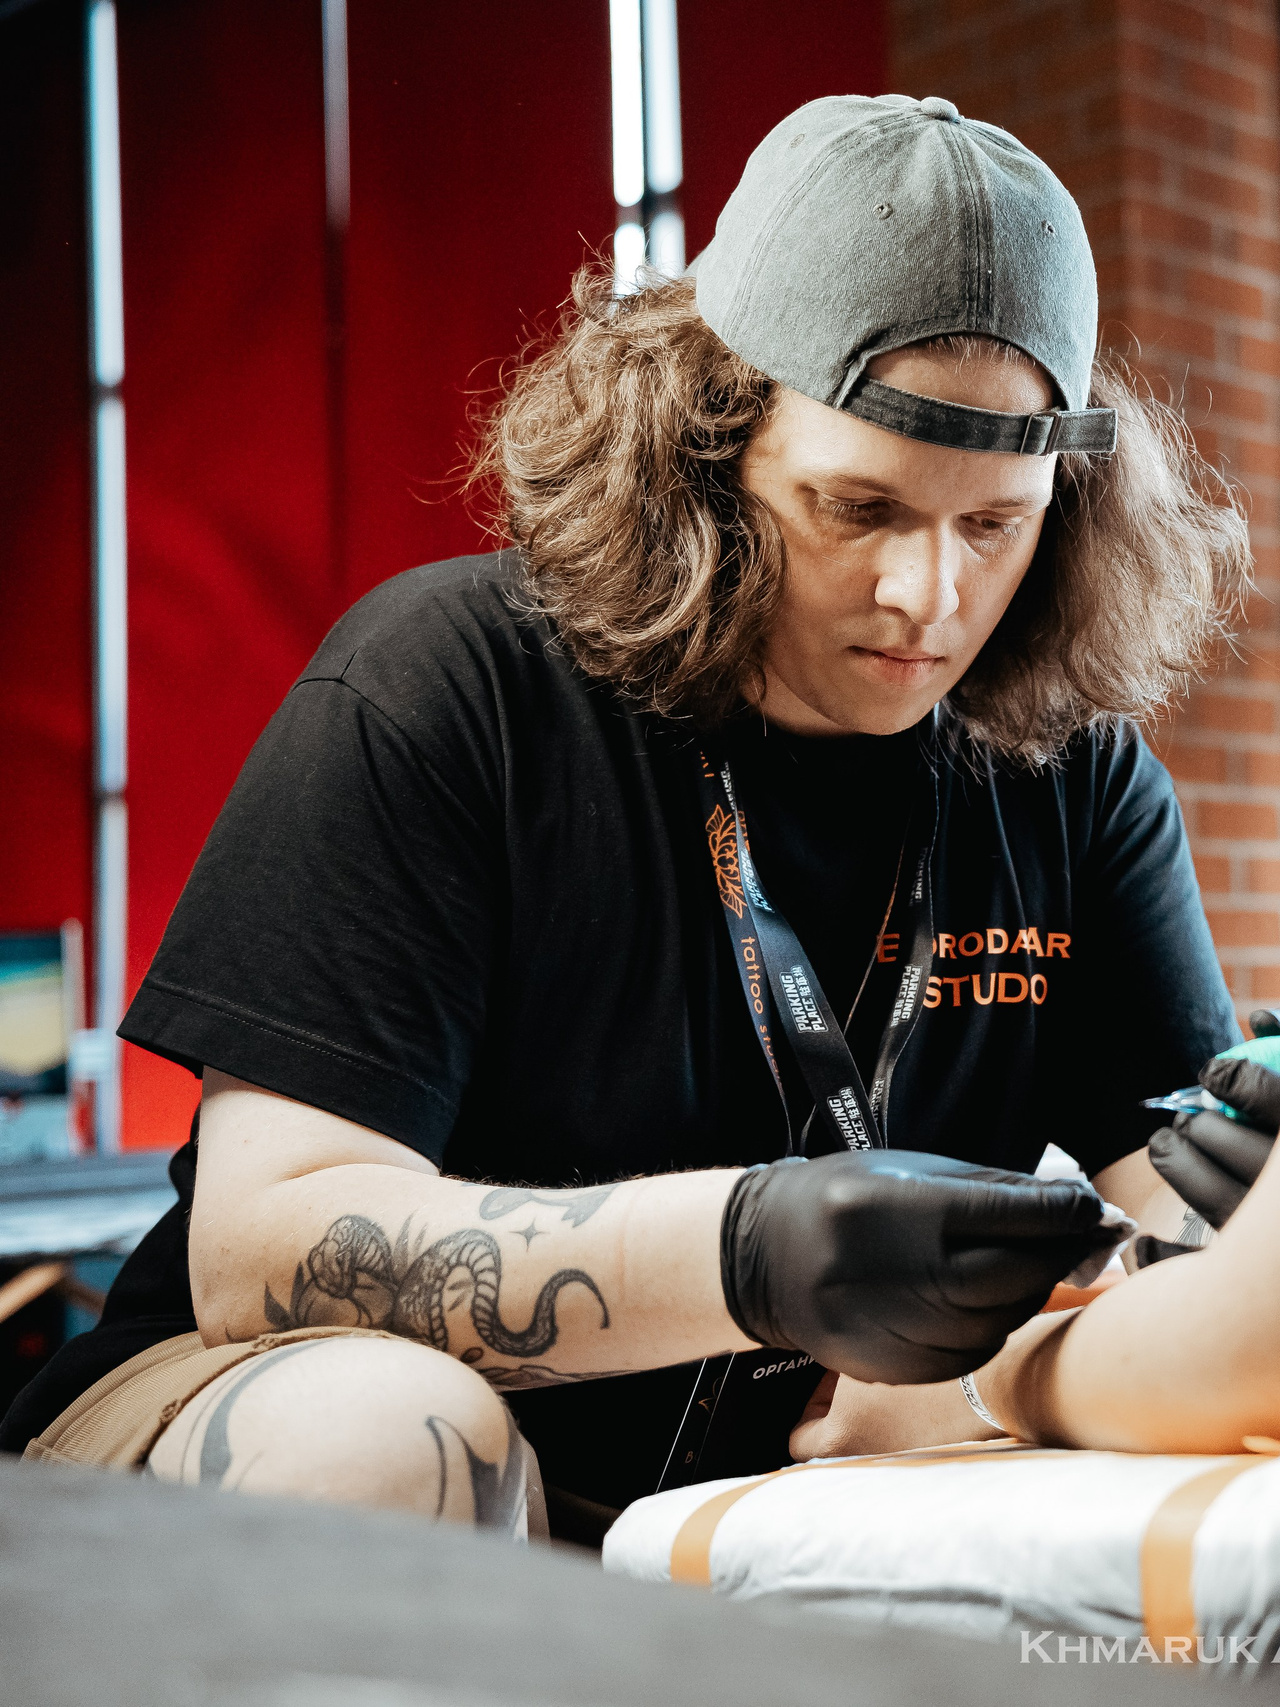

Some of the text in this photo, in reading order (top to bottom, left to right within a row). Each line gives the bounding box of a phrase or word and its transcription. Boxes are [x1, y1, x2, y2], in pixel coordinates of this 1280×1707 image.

[741, 936, 764, 1015] tattoo
[781, 974, 812, 1032] PARKING
[901, 966, 921, 1021] PARKING
[801, 998, 826, 1032] PLACE
